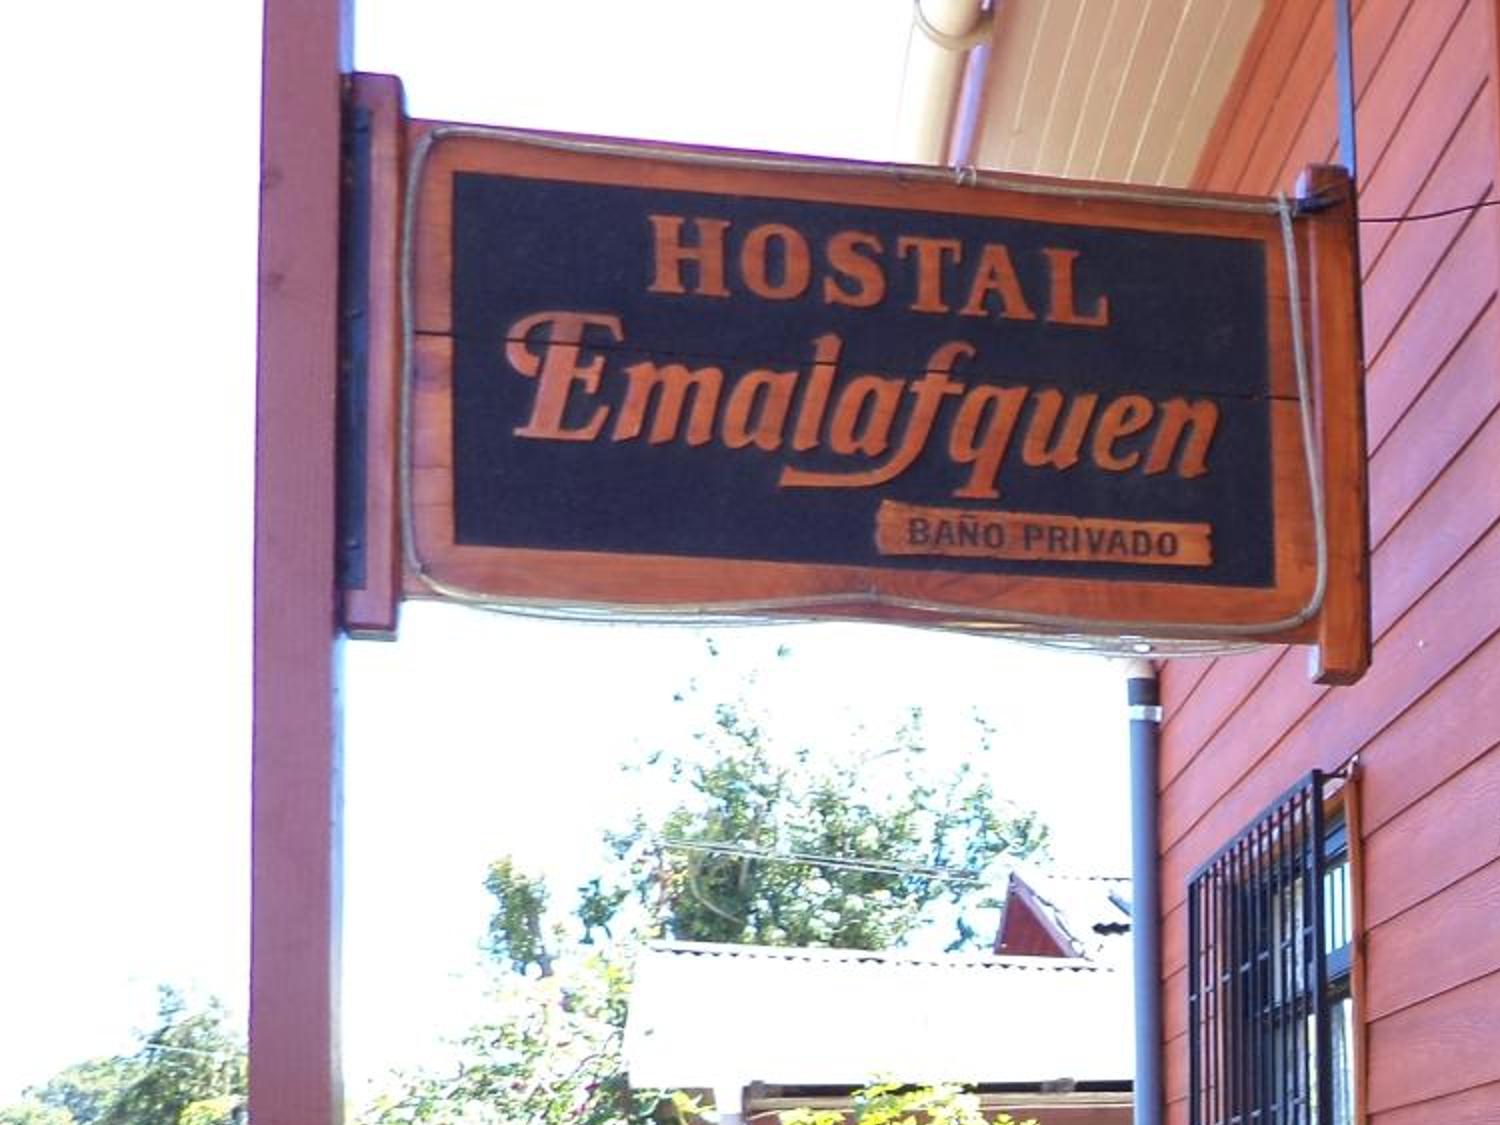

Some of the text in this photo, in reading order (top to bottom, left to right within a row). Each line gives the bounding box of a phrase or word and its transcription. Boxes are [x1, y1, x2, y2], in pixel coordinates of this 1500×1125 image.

[647, 213, 1109, 326] HOSTAL
[505, 310, 1218, 498] Emalafquen
[908, 513, 1179, 557] BAÑO PRIVADO
